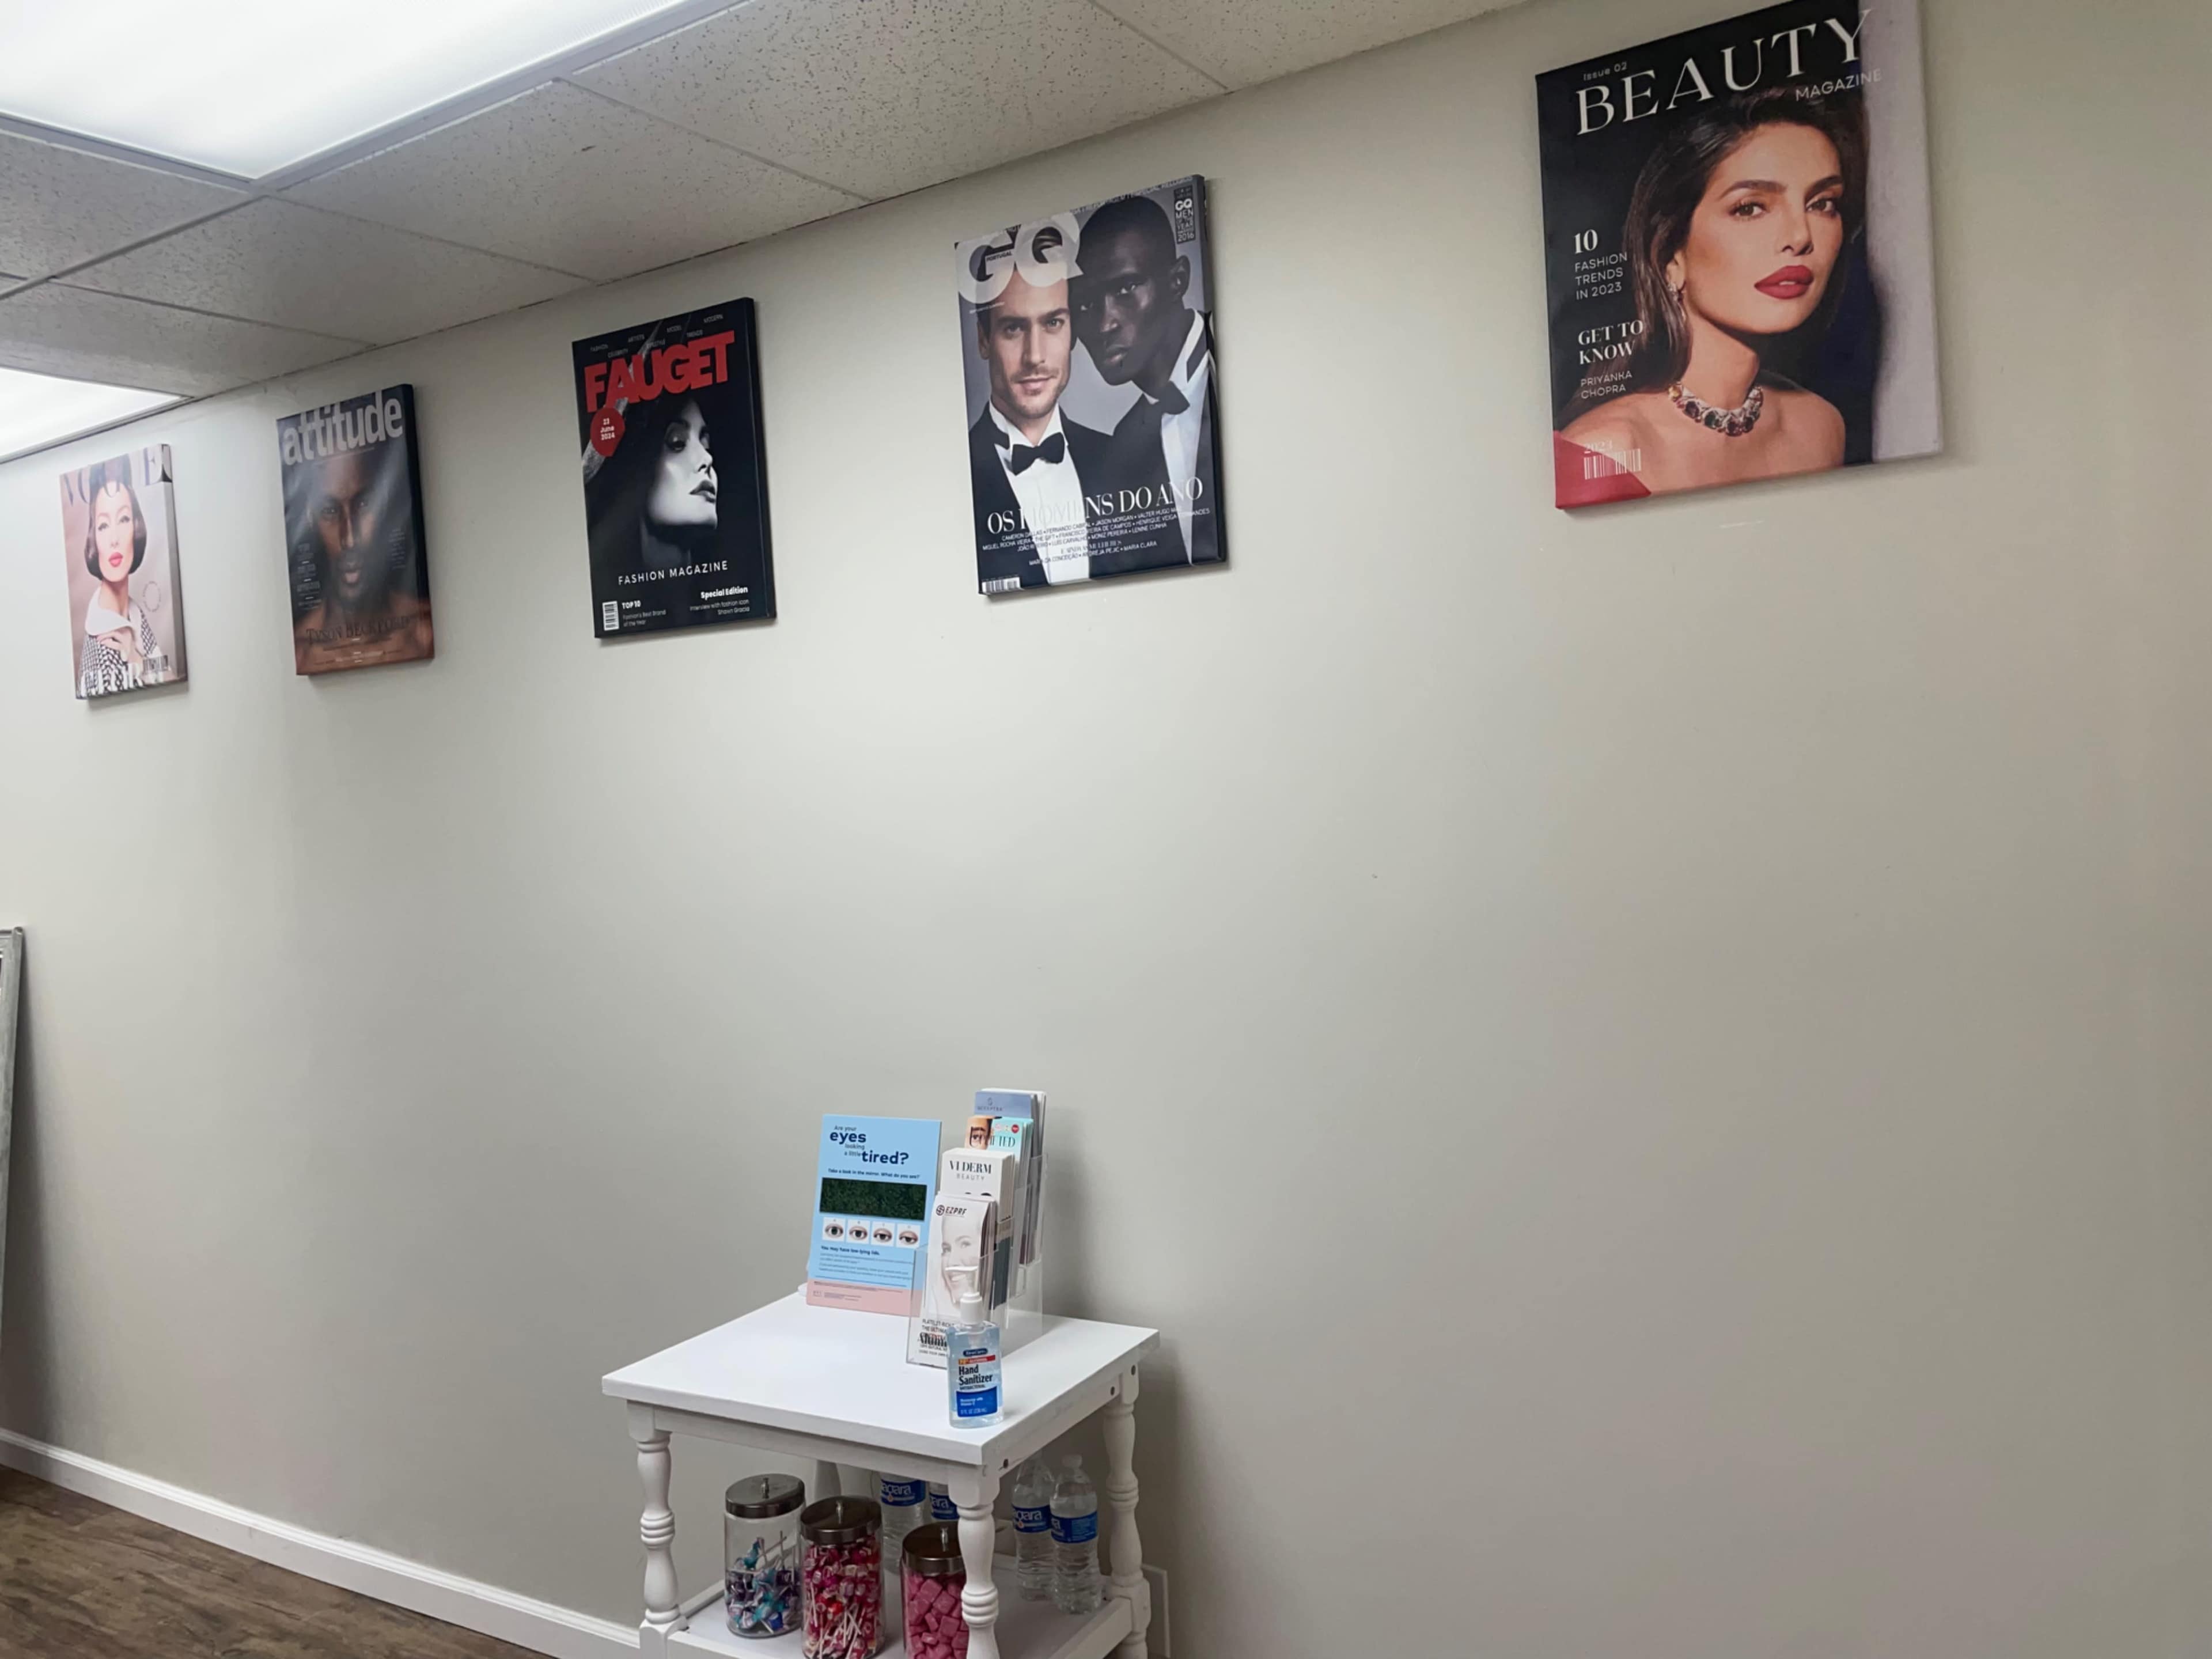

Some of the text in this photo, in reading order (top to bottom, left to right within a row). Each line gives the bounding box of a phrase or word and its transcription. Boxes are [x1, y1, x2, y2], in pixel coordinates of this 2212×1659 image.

[1576, 9, 1871, 135] BEAUTY
[1583, 61, 1627, 81] Issue 02
[1795, 68, 1882, 101] MAGAZINE
[1175, 198, 1193, 211] GQ
[1176, 209, 1194, 219] MEN
[1177, 232, 1194, 242] 2016
[1574, 229, 1599, 254] 10
[956, 212, 1084, 304] GQ
[986, 251, 1013, 262] PORTUGAL
[1574, 251, 1628, 273] FASHION
[1575, 267, 1624, 286] TRENDS
[1575, 281, 1622, 300] IN 2023
[1578, 319, 1643, 347] GET TO
[1579, 339, 1636, 365] KNOW
[584, 330, 735, 413] FAUGET
[1580, 369, 1633, 388] PRIYANKA
[1580, 384, 1627, 399] CHOPRA
[283, 389, 403, 465] attitude
[987, 510, 1015, 535] OS
[1119, 486, 1152, 513] DO
[1156, 476, 1203, 506] ANO
[618, 560, 729, 585] FASHION MAGAZINE
[700, 585, 748, 601] Special Edition
[622, 600, 642, 609] TOP 10
[720, 600, 738, 608] fashion
[652, 609, 666, 617] Brand
[306, 624, 342, 646] TYSON
[830, 1131, 866, 1145] eyes
[844, 1143, 865, 1151] looking
[862, 1150, 909, 1165] tired?
[949, 1160, 992, 1175] VI DERM
[956, 1173, 985, 1181] BEAUTY
[959, 1364, 979, 1376] Hand
[959, 1373, 993, 1386] Sanitizer
